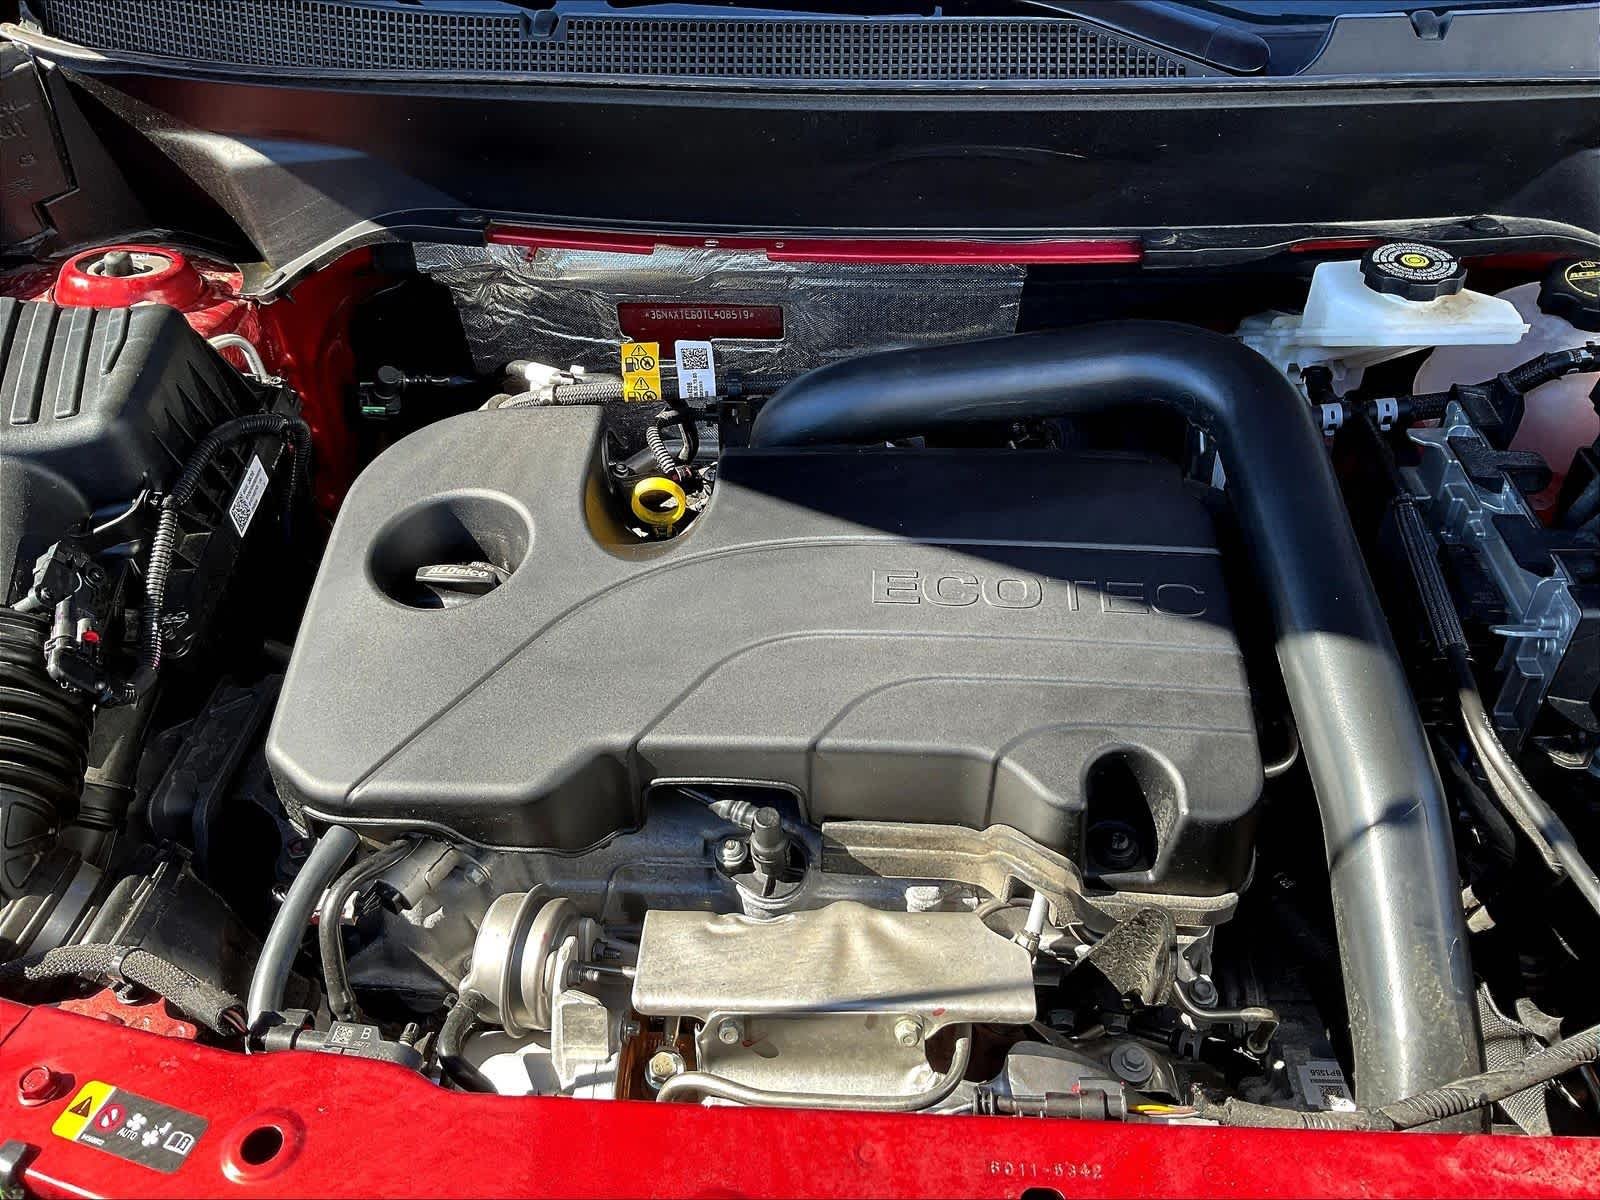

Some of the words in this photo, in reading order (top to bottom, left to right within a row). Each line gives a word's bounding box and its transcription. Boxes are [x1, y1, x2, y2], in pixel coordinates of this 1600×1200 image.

[426, 566, 489, 577] ACDelco
[872, 568, 1206, 618] ECOTEC
[360, 1027, 372, 1040] B
[117, 1127, 138, 1141] AUTO
